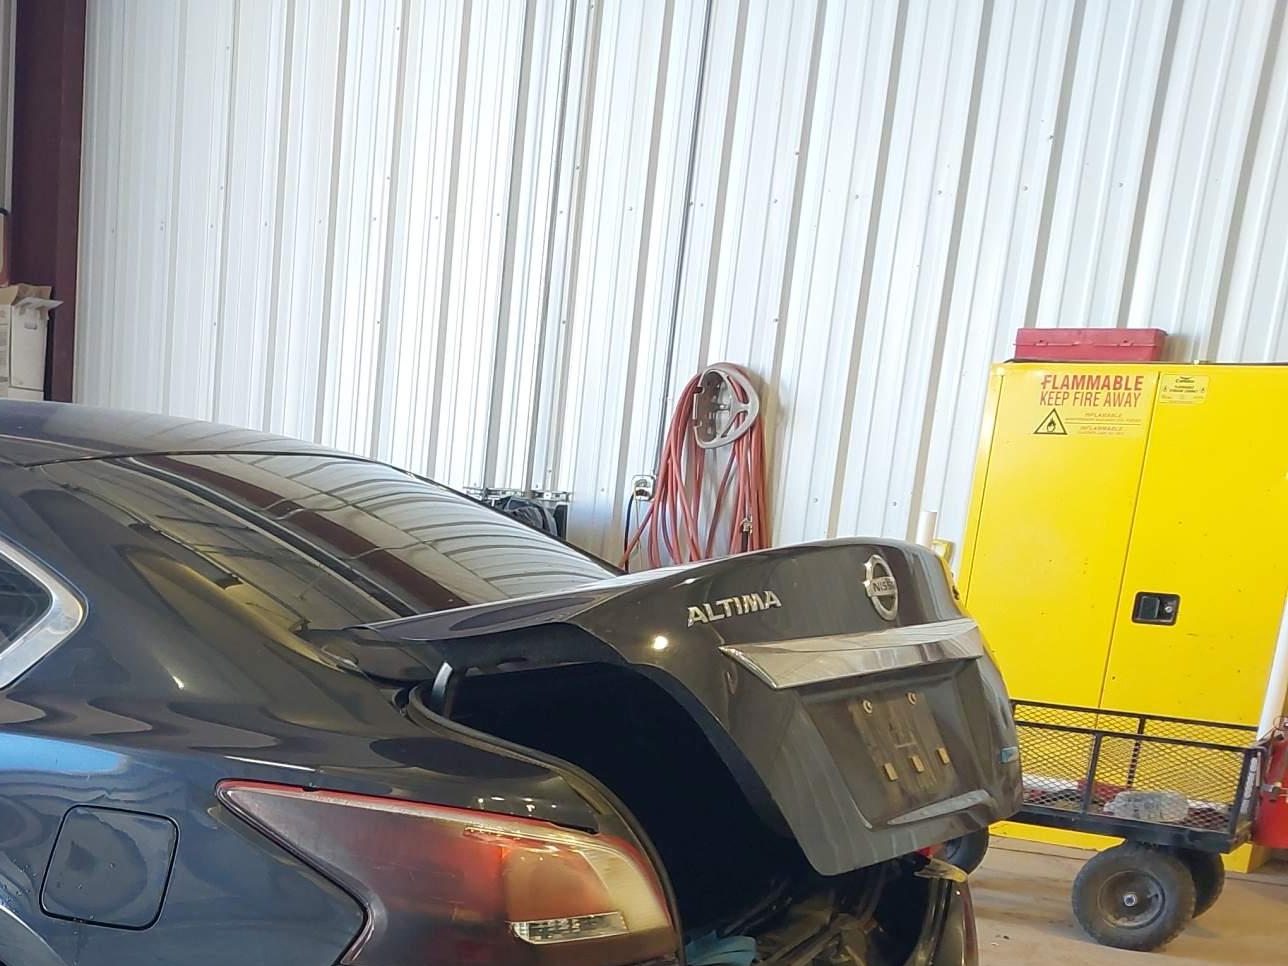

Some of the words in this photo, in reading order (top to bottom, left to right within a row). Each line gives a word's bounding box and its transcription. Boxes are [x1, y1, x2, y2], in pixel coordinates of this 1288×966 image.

[1040, 374, 1144, 391] FLAMMABLE
[1039, 391, 1069, 406] KEEP
[1072, 391, 1101, 407] FIRE
[1103, 392, 1142, 408] AWAY
[687, 590, 782, 628] ALTIMA
